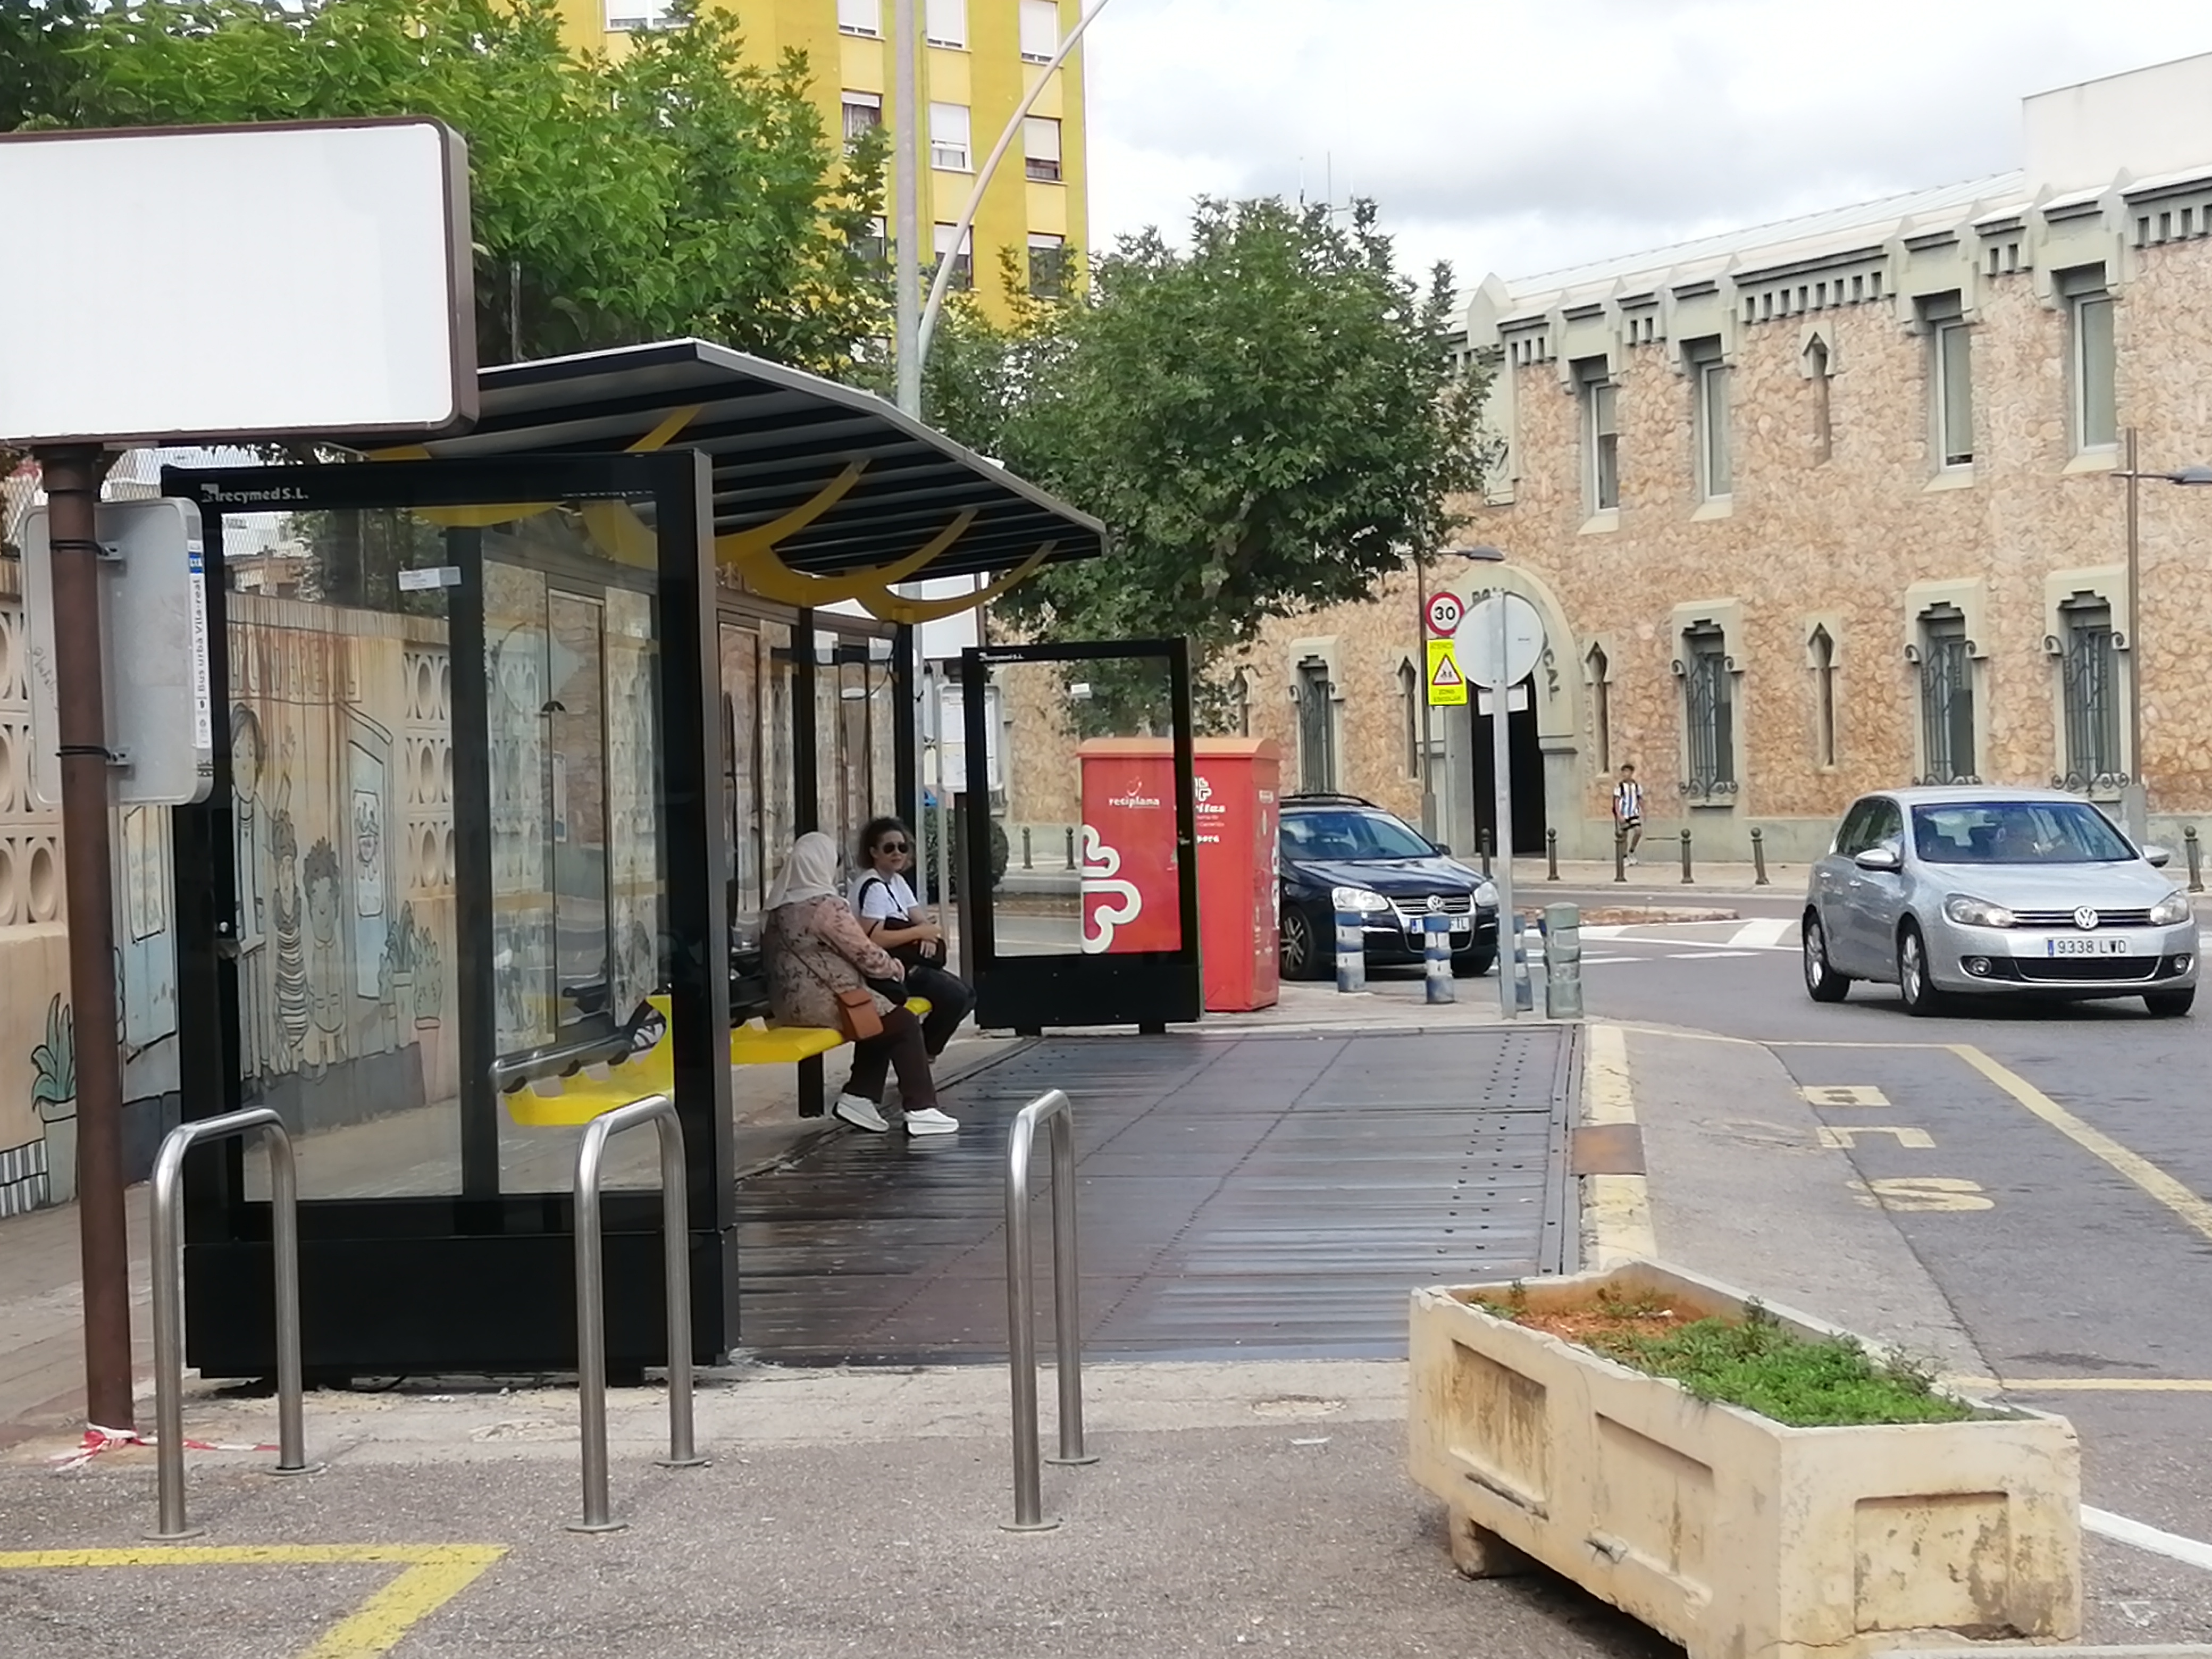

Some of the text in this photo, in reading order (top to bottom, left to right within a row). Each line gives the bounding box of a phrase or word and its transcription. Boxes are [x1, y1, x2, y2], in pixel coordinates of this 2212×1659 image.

[219, 487, 309, 504] recymed S.L.
[1435, 606, 1456, 621] 30
[197, 669, 205, 692] Bus
[2057, 940, 2094, 954] 9338
